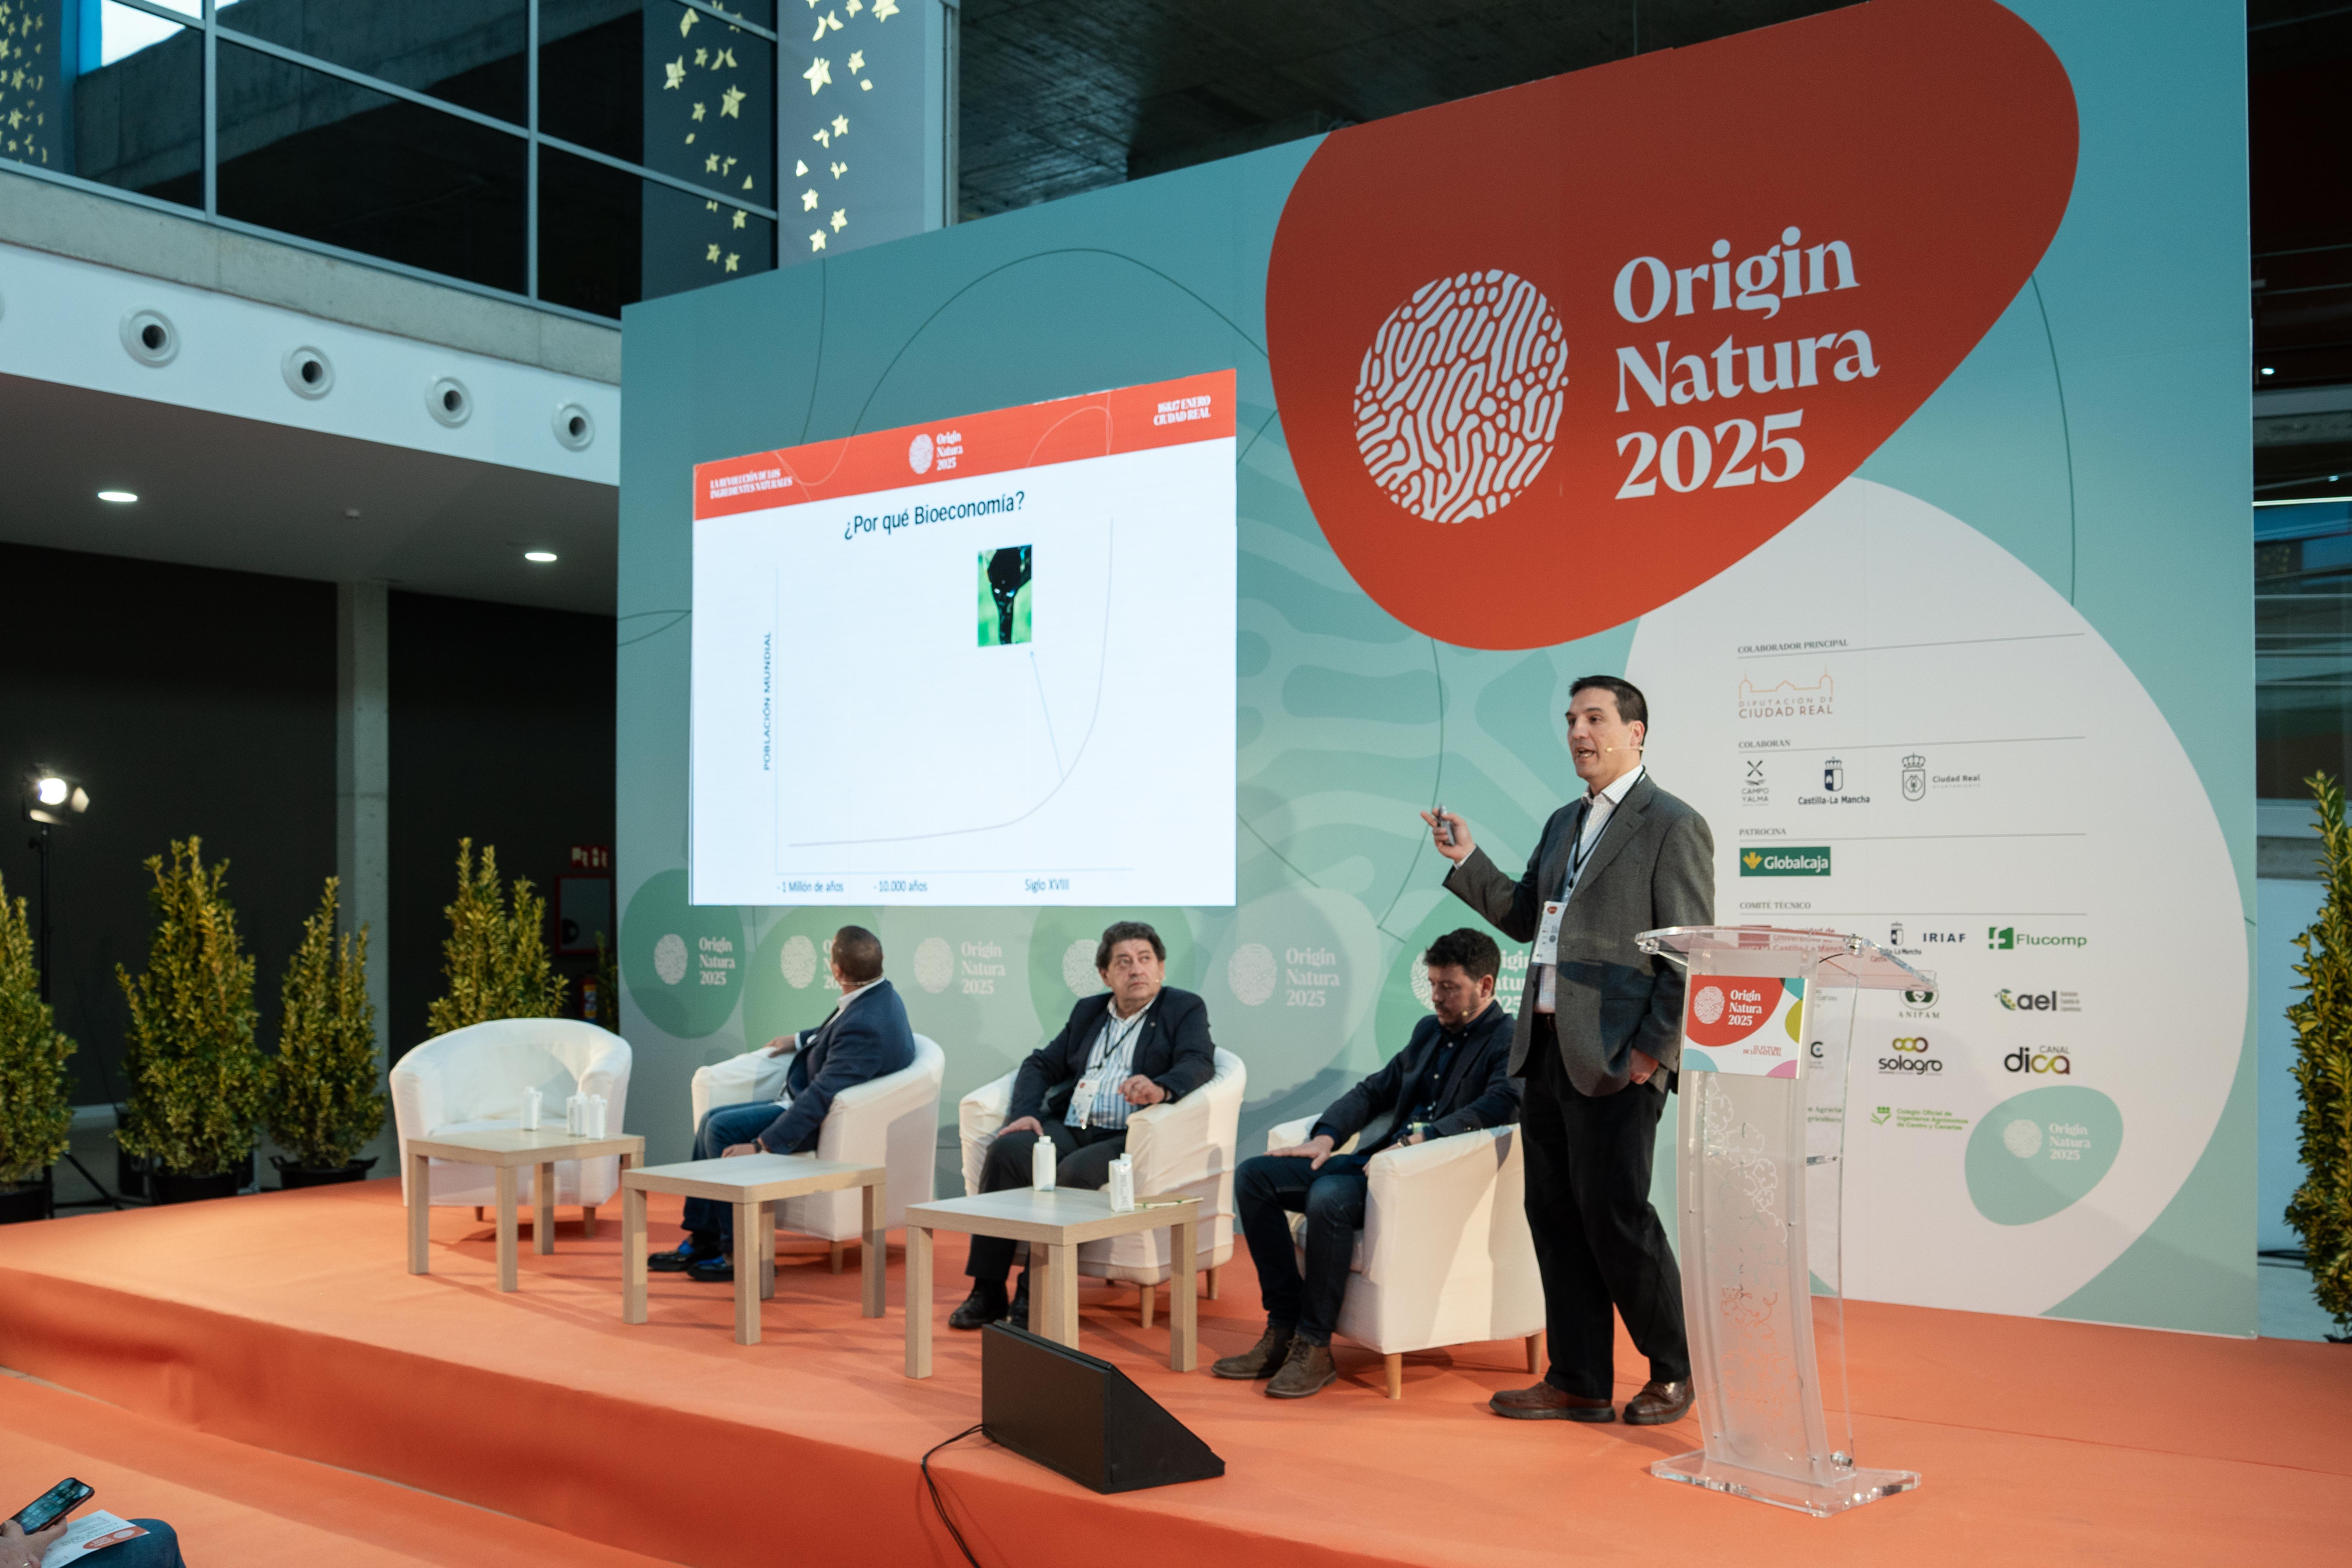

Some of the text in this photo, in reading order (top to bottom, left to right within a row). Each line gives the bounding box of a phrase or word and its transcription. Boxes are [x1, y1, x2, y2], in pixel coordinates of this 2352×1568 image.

[1614, 226, 1861, 323] Origin
[1615, 329, 1881, 413] Natura
[1181, 395, 1211, 410] ENERO
[1153, 406, 1211, 426] CIUDAD REAL
[936, 430, 961, 445] Origin
[936, 445, 963, 458] Natura
[1615, 409, 1805, 500] 2025
[936, 457, 957, 471] 2025
[844, 491, 1025, 539] ¿Por qué Bioeconomía?
[1738, 639, 1848, 653] COLABORADOR PRINCIPAL
[1739, 705, 1833, 719] CIUDAD REAL
[762, 696, 771, 771] POBLACIÓN
[1738, 740, 1790, 748] COLABORAN
[1932, 773, 1980, 783] Ciudad Real
[1841, 795, 1870, 804] Mancha
[1739, 828, 1786, 836] PATROCINA
[1764, 855, 1829, 873] Globalcaja
[814, 880, 823, 892] de
[826, 879, 844, 892] años
[879, 880, 907, 893] 10.000
[908, 879, 928, 892] años
[1025, 877, 1070, 894] Siglo XVIII
[1739, 900, 1811, 910] COMITÉ TÉCNICO
[699, 936, 733, 954] Origin
[1922, 933, 1966, 943] IRIAF
[2016, 933, 2087, 948] Flucomp
[961, 940, 1003, 959] Origin
[700, 954, 735, 969] Natura
[1286, 947, 1336, 968] Origin
[962, 960, 1006, 976] Natura
[700, 970, 727, 985] 2025
[1286, 969, 1340, 986] Natura
[962, 979, 995, 994] 2025
[1286, 989, 1326, 1007] 2025
[1730, 989, 1761, 1003] Origin
[2017, 990, 2057, 1011] ael
[1729, 1002, 1762, 1014] Natura
[1728, 1015, 1753, 1026] 2025
[2039, 1045, 2070, 1055] CANAL
[1879, 1055, 1942, 1075] solagro
[2004, 1046, 2071, 1075] dica
[2049, 1123, 2088, 1136] Origin
[2050, 1136, 2092, 1148] Natura
[2050, 1148, 2081, 1161] 2025
